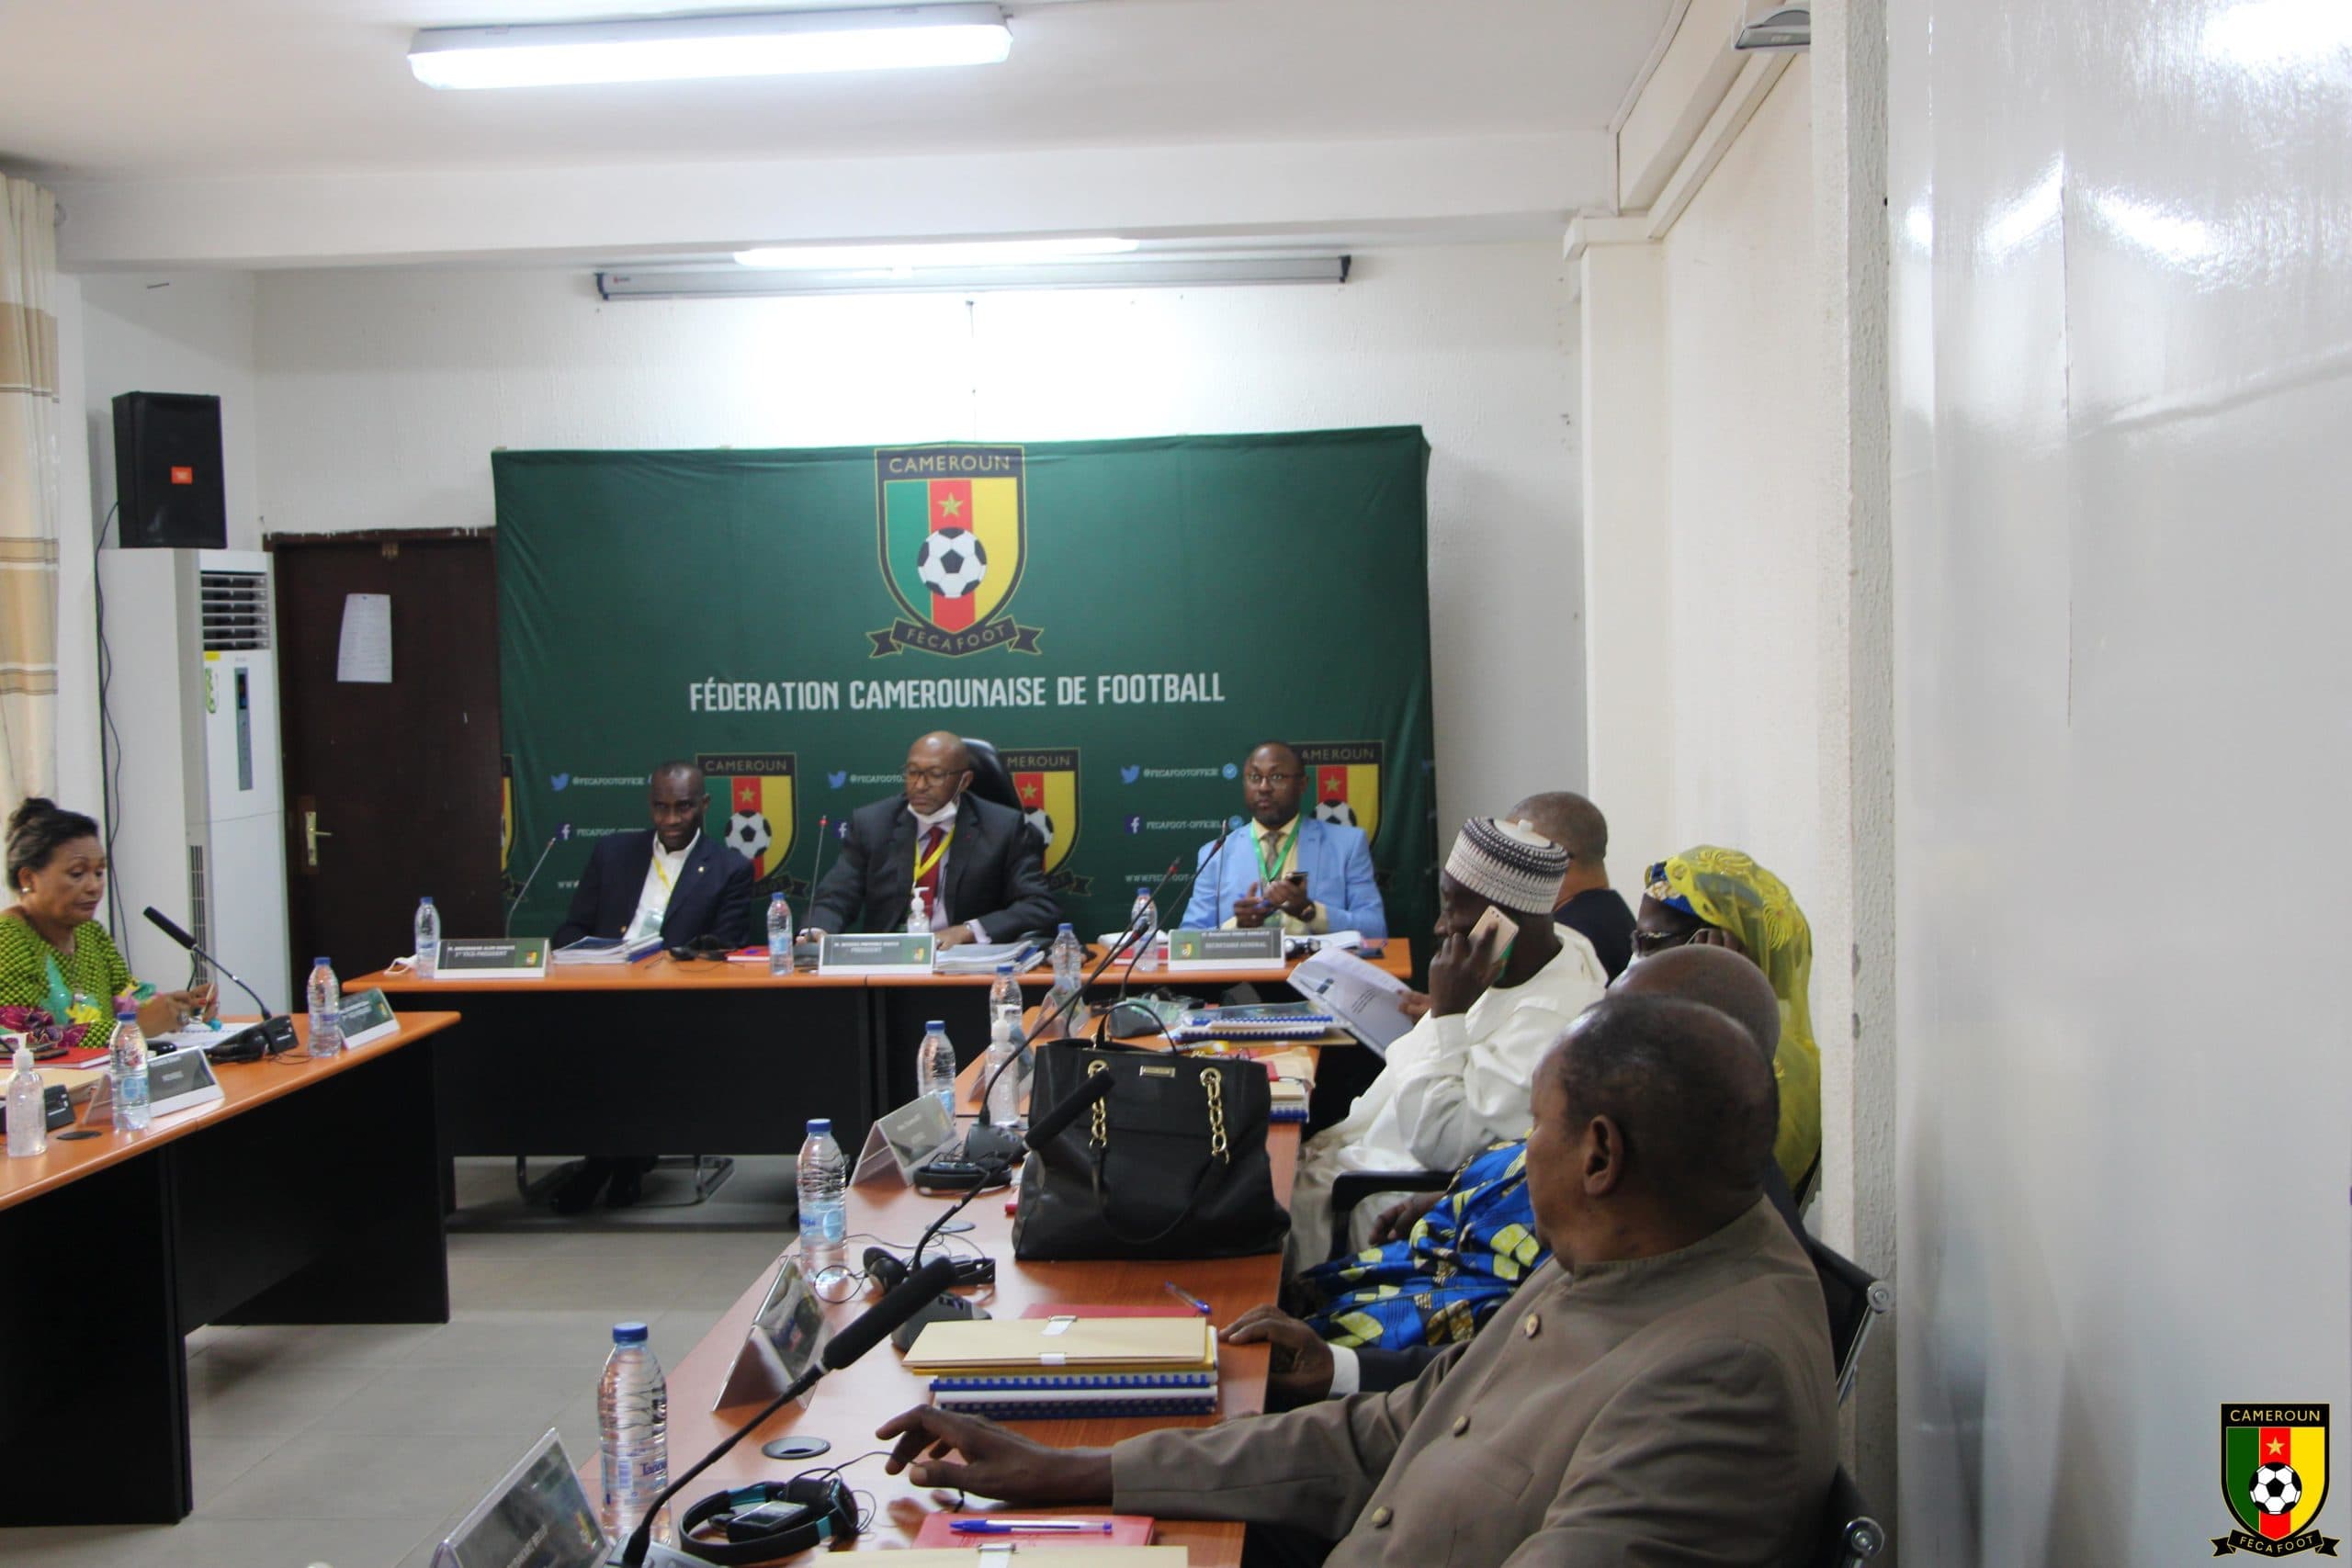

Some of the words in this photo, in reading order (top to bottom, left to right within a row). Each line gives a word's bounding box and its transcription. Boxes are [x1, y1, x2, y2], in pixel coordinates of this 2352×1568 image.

[889, 456, 1010, 473] CAMEROUN
[906, 625, 1006, 650] FECAFOOT
[689, 676, 840, 712] FÉDERATION
[849, 676, 1046, 710] CAMEROUNAISE
[1057, 675, 1087, 705] DE
[1098, 671, 1226, 705] FOOTBALL
[1007, 756, 1070, 767] MEROUN
[1301, 749, 1374, 761] AMEROUN
[705, 760, 786, 772] CAMEROUN
